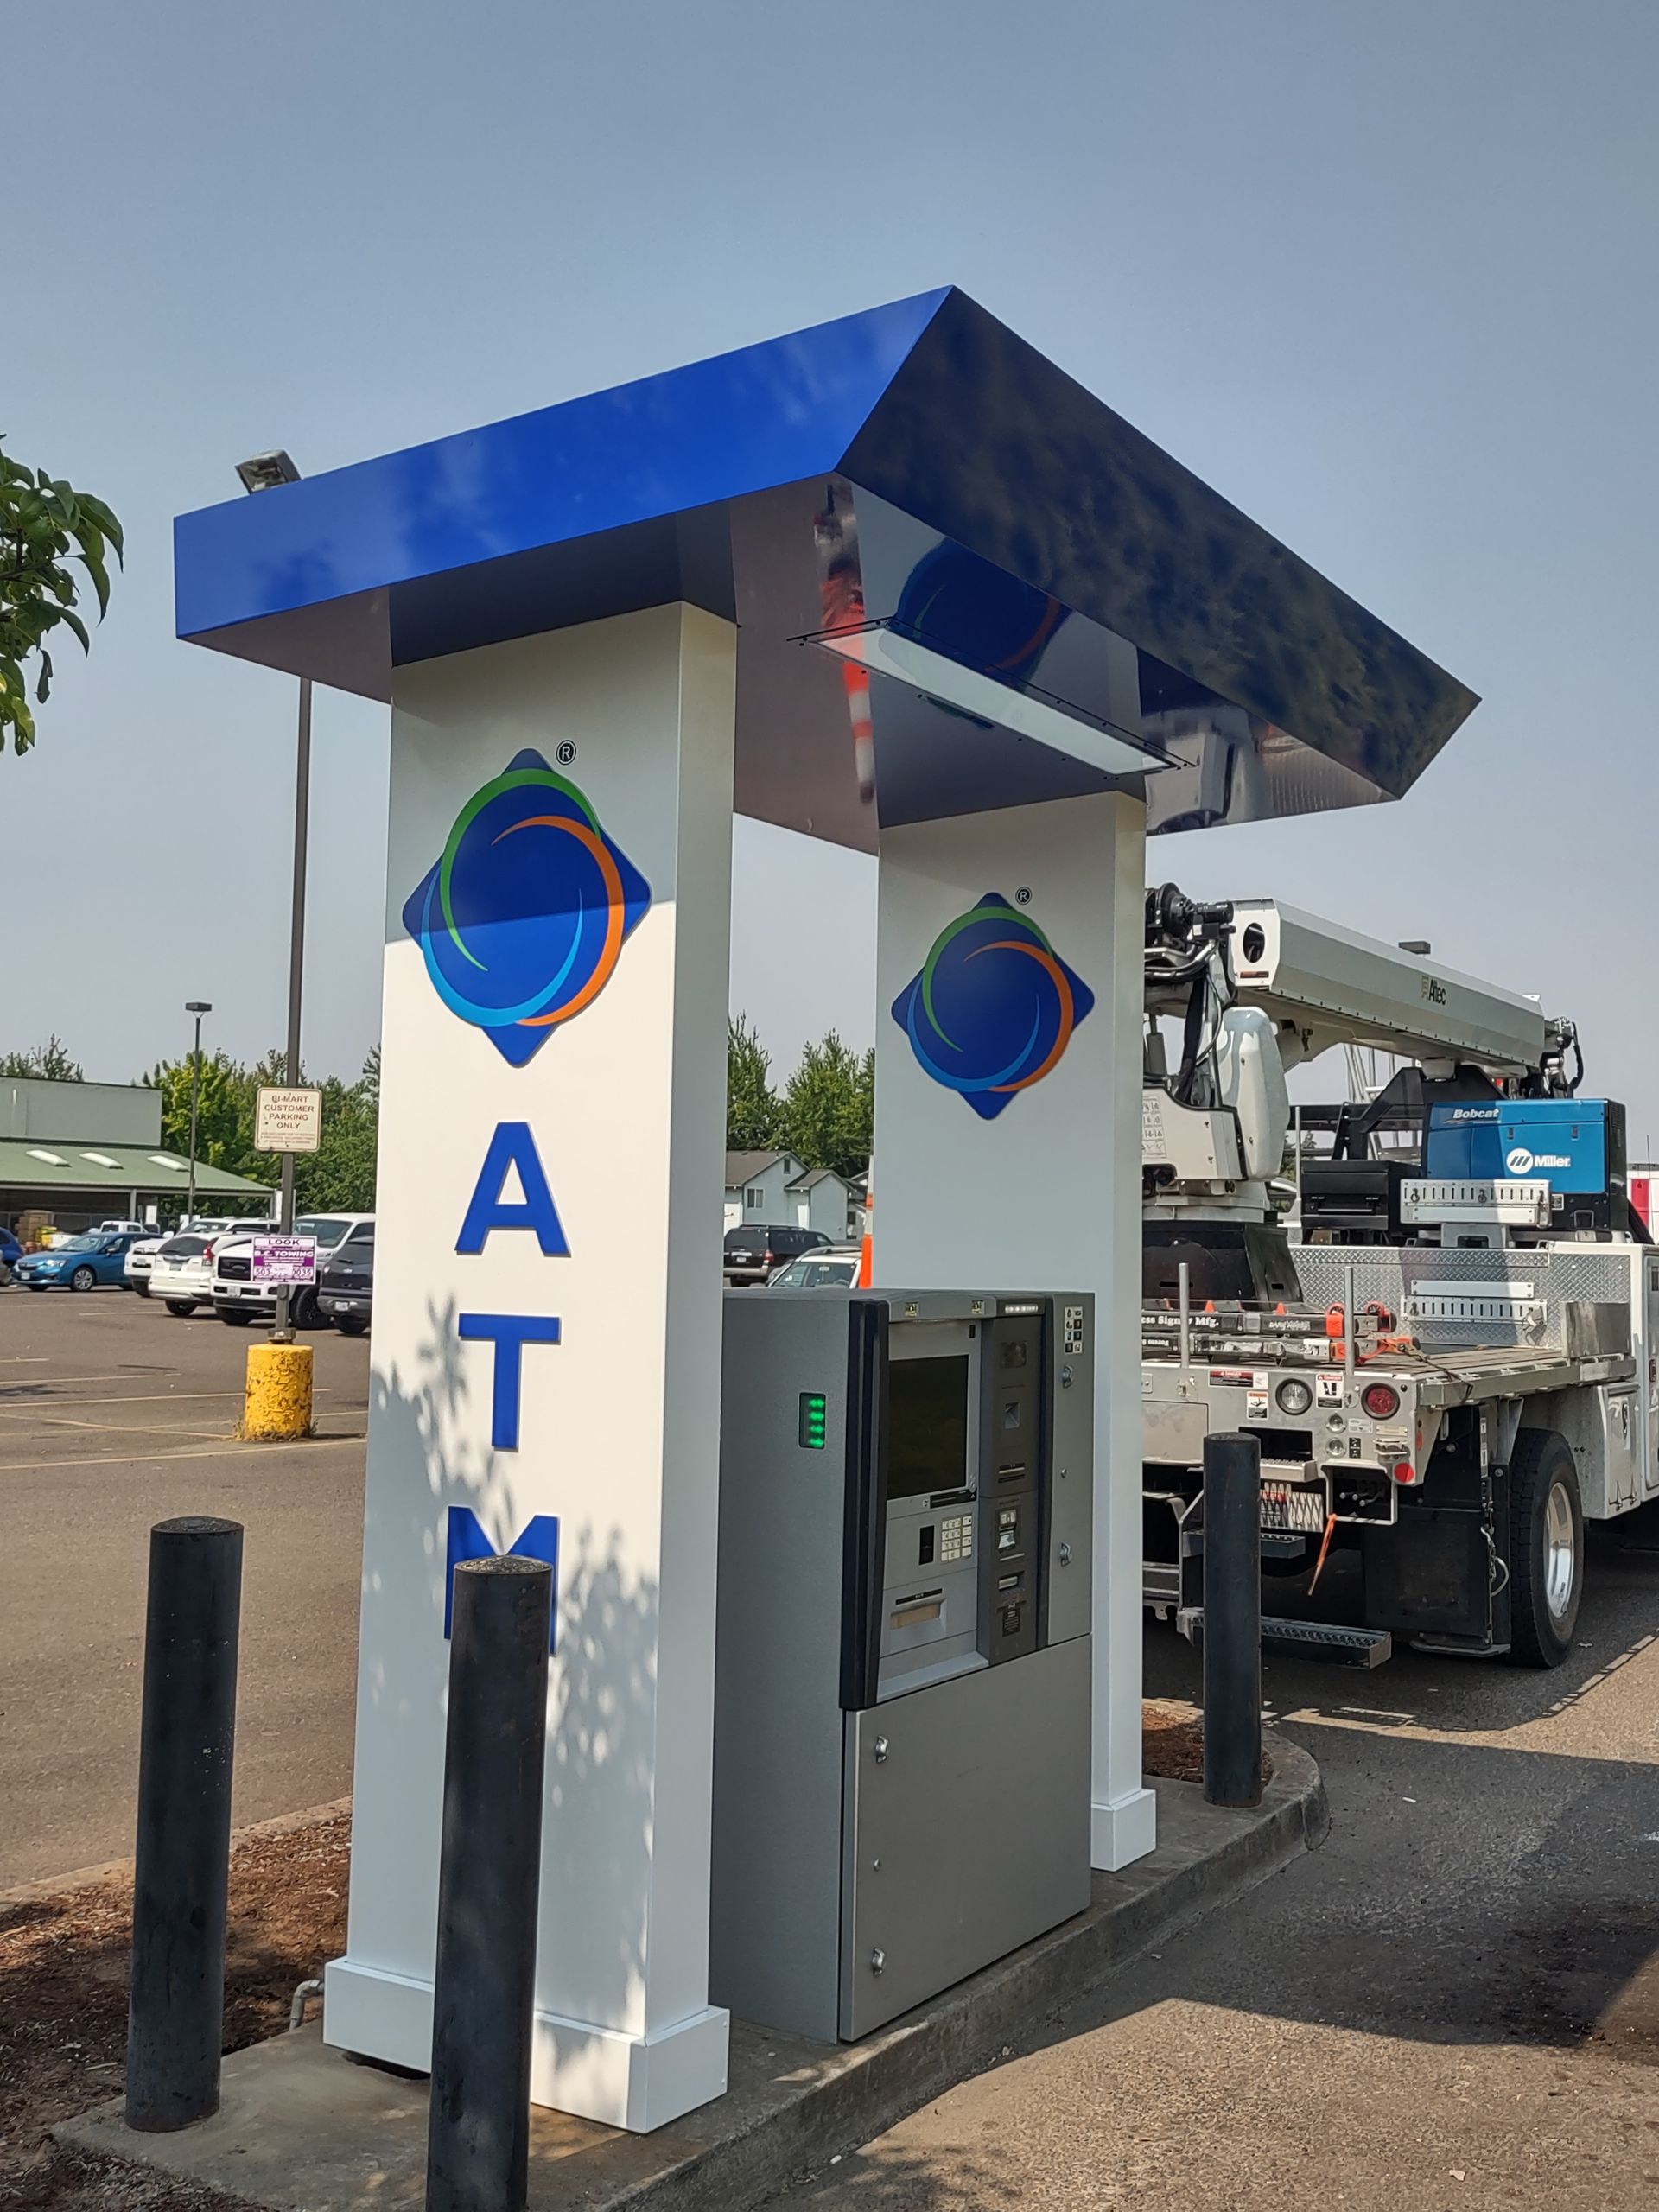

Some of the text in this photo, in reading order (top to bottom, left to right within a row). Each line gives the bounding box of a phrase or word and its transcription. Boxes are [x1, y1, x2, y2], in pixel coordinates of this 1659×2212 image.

[1428, 978, 1446, 1006] Altec
[1452, 1108, 1499, 1119] Bobcat
[1195, 1316, 1219, 1328] Mfg.
